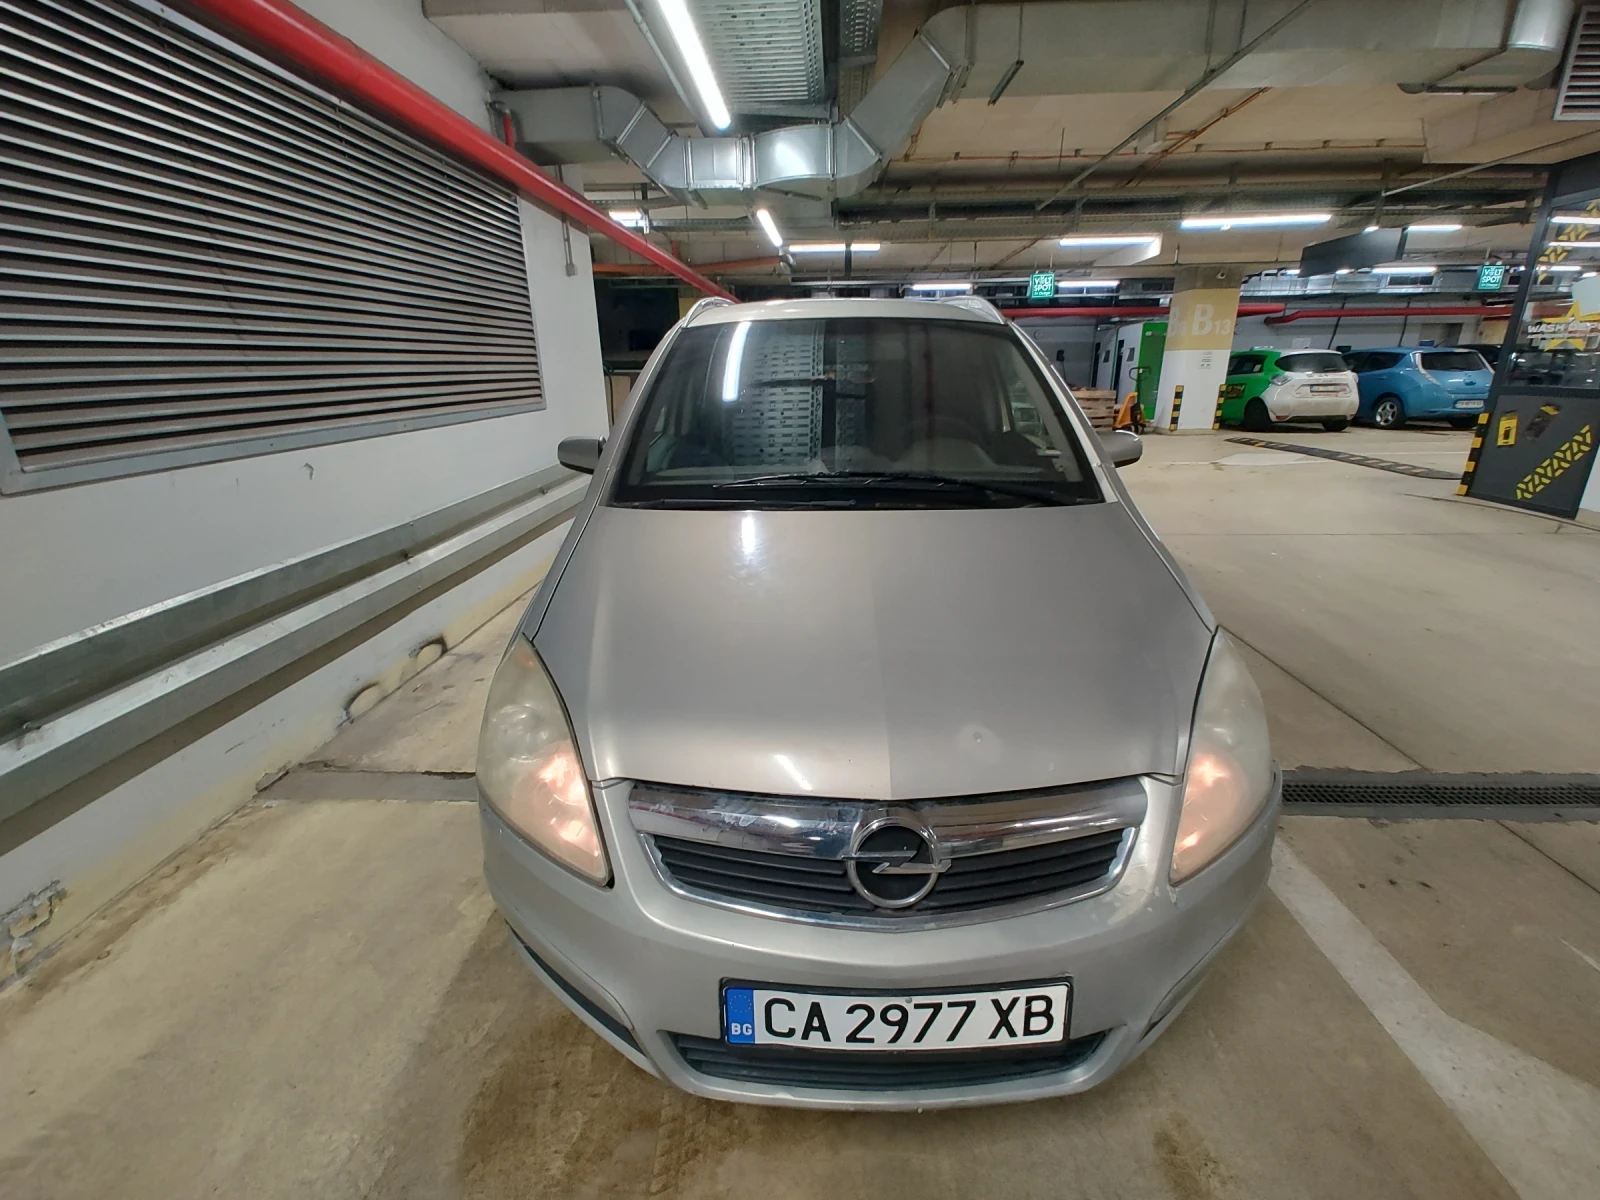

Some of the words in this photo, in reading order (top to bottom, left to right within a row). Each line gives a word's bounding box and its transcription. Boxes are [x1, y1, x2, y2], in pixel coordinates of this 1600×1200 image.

[1481, 275, 1502, 283] SPOT
[1033, 284, 1052, 292] SPOT
[1192, 304, 1231, 335] B13
[1527, 323, 1565, 333] WASH
[764, 997, 832, 1043] CA
[845, 1000, 977, 1044] 2977
[988, 994, 1055, 1040] XB
[731, 1023, 753, 1036] BG
